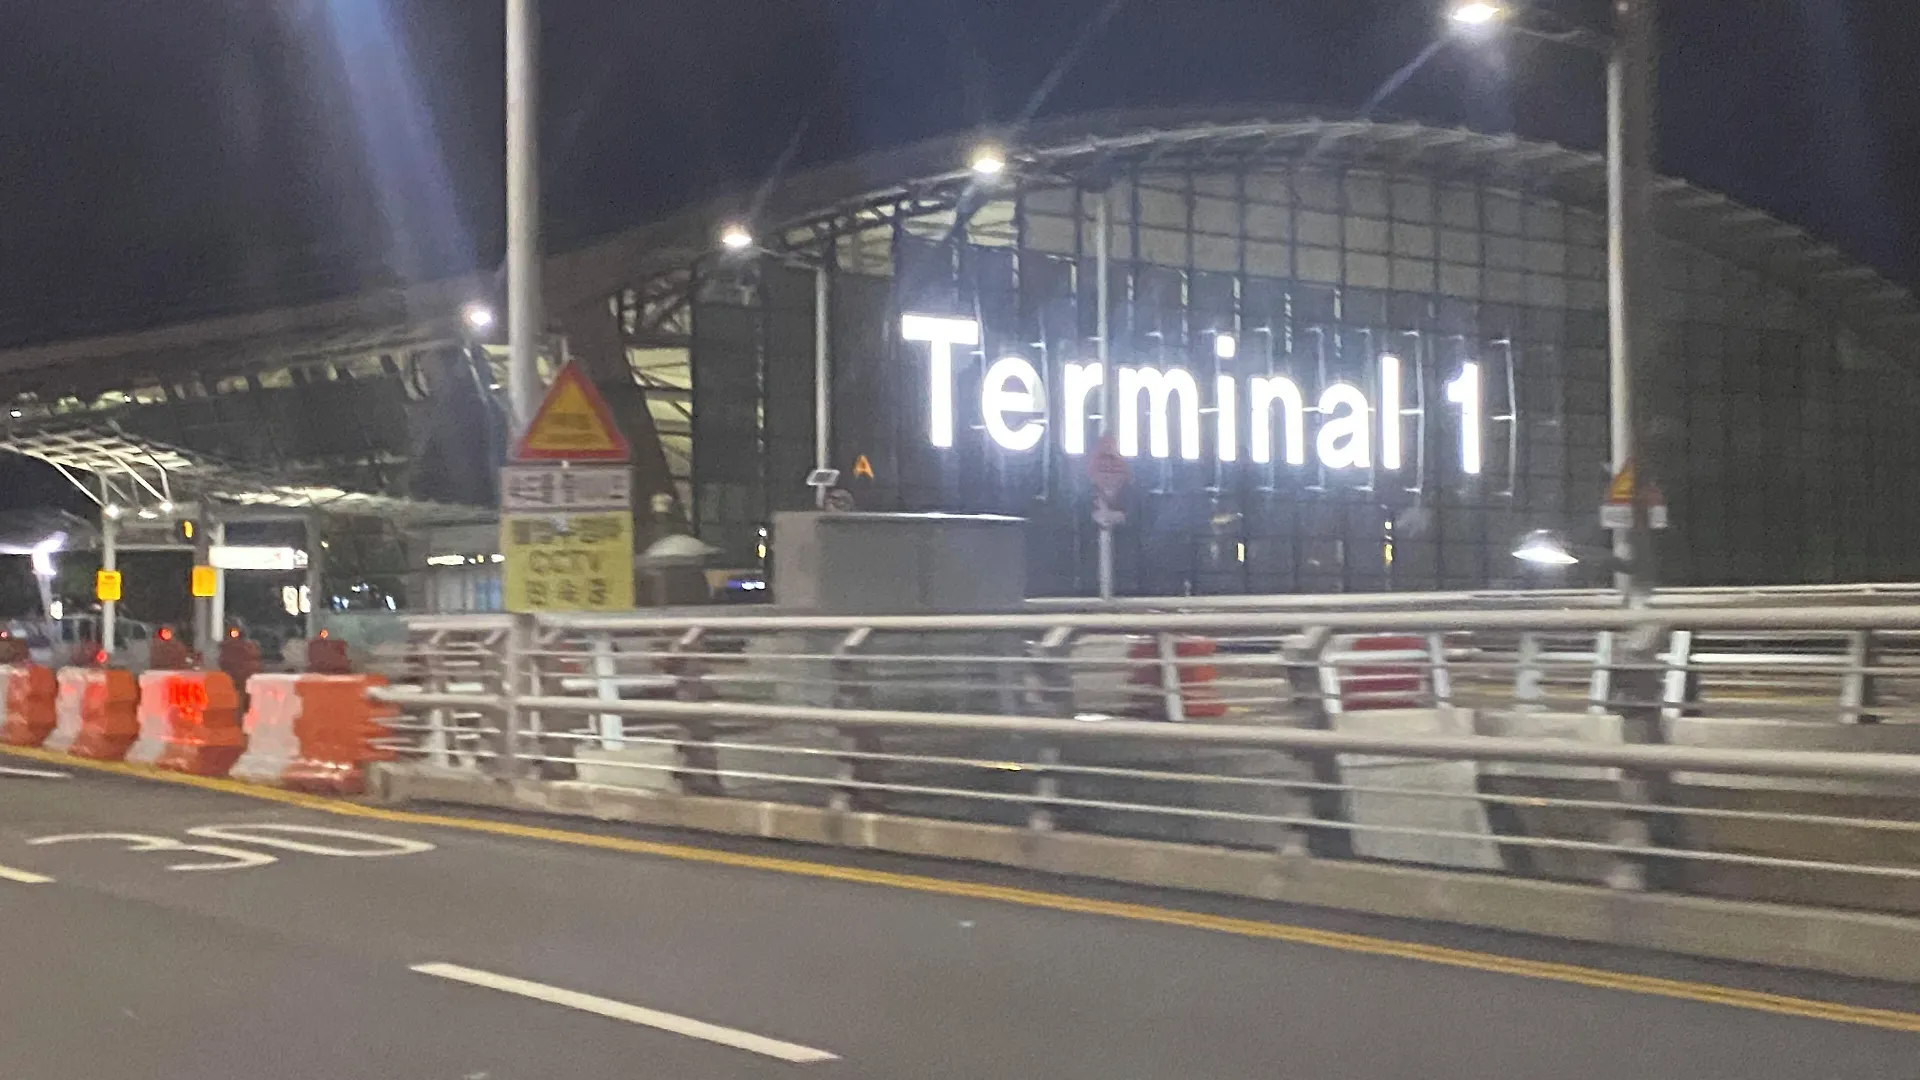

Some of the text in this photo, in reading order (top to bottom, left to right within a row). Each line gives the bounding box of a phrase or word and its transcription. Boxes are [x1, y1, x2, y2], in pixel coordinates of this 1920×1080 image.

[901, 313, 1482, 475] Terminal 1
[529, 550, 601, 575] CCTV
[24, 823, 438, 872] 30
